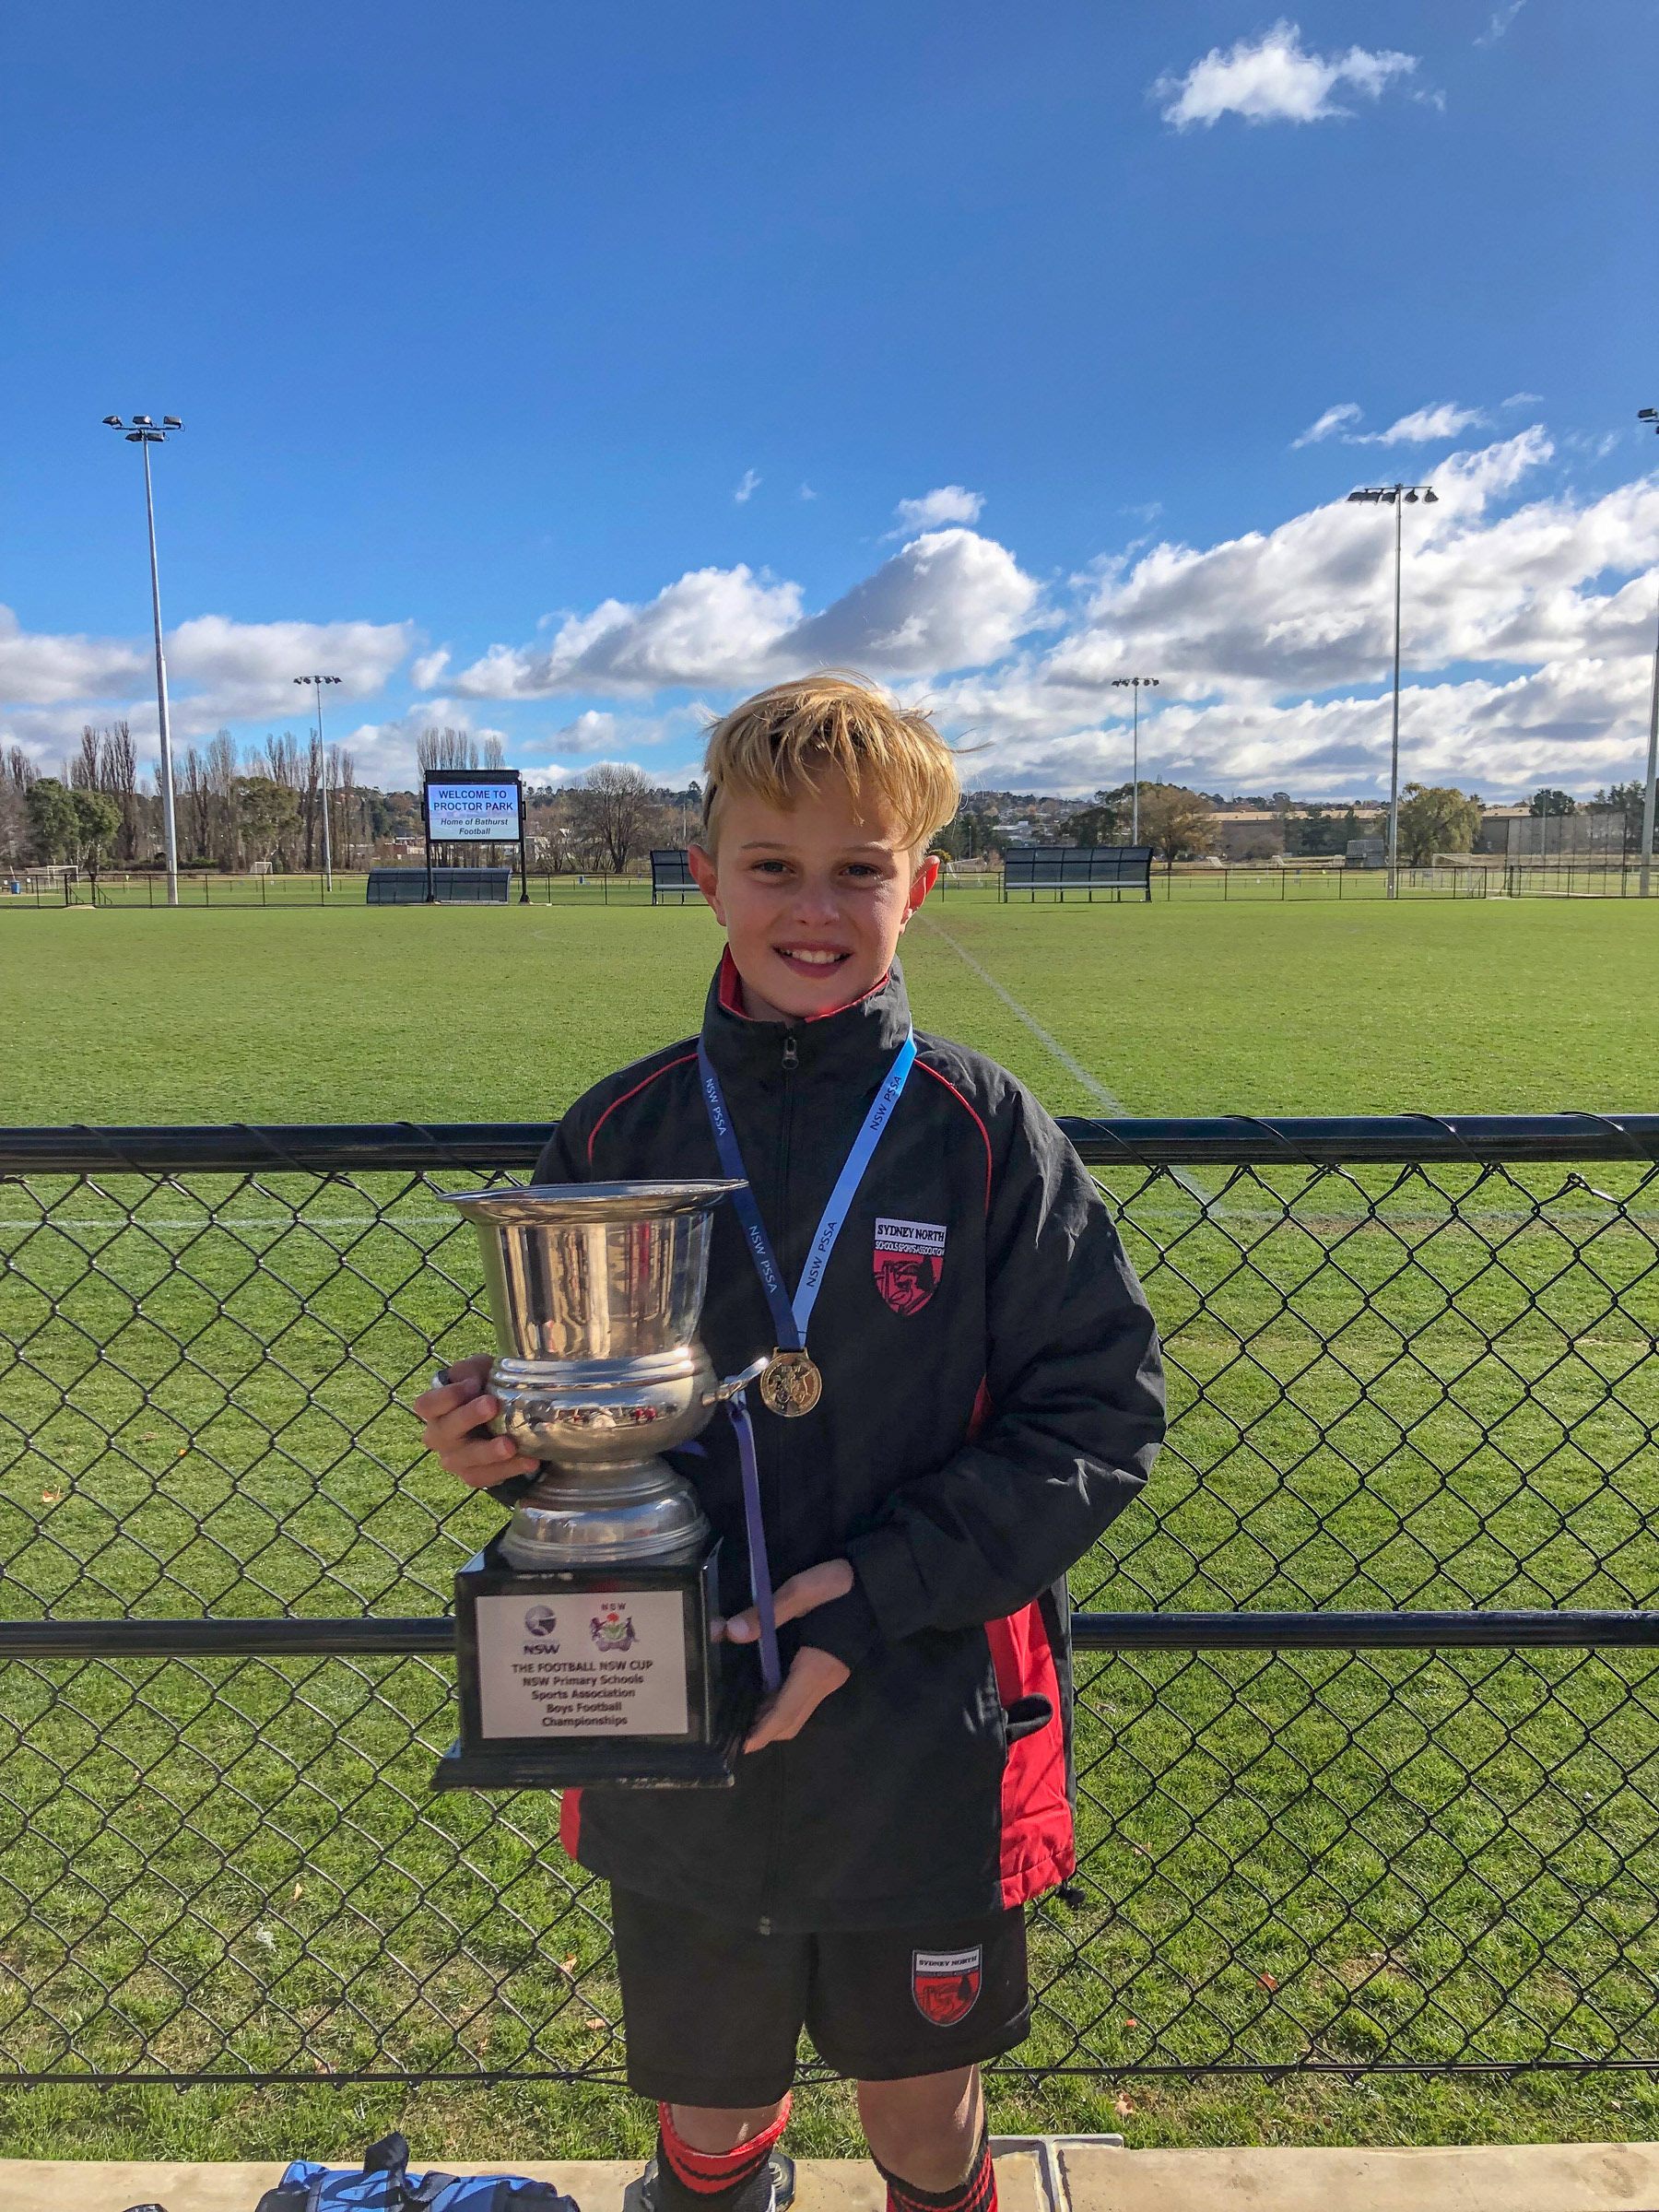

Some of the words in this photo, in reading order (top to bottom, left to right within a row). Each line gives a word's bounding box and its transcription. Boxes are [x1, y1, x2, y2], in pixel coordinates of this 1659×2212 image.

[439, 790, 490, 799] WELCOME
[493, 790, 507, 799] TO
[433, 802, 482, 811] PROCTOR
[486, 802, 513, 811] PARK
[706, 1077, 719, 1103] NSW
[869, 1103, 888, 1131] NSW
[883, 1076, 902, 1102] PSSA
[712, 1106, 727, 1135] PSSA
[877, 1224, 914, 1239] SYDNEY
[915, 1229, 945, 1242] NORTH
[748, 1225, 766, 1254] NSW
[760, 1259, 778, 1293] PSSA
[806, 1256, 823, 1288] NSW
[818, 1221, 838, 1253] PSSA
[601, 1603, 627, 1611] NSW
[524, 1644, 560, 1654] NSW
[511, 1663, 534, 1673] THE
[538, 1662, 595, 1673] FOOTBALL
[600, 1661, 627, 1671] NSW
[629, 1660, 653, 1671] CUP
[523, 1677, 549, 1687] NSW
[553, 1676, 597, 1688] Primary
[600, 1674, 644, 1685] Schools
[532, 1689, 568, 1701] Sports
[571, 1688, 635, 1700] Association
[547, 1703, 573, 1714] Boys
[577, 1701, 622, 1712] Football
[542, 1714, 628, 1727] Championships
[951, 1955, 977, 1966] NORTH
